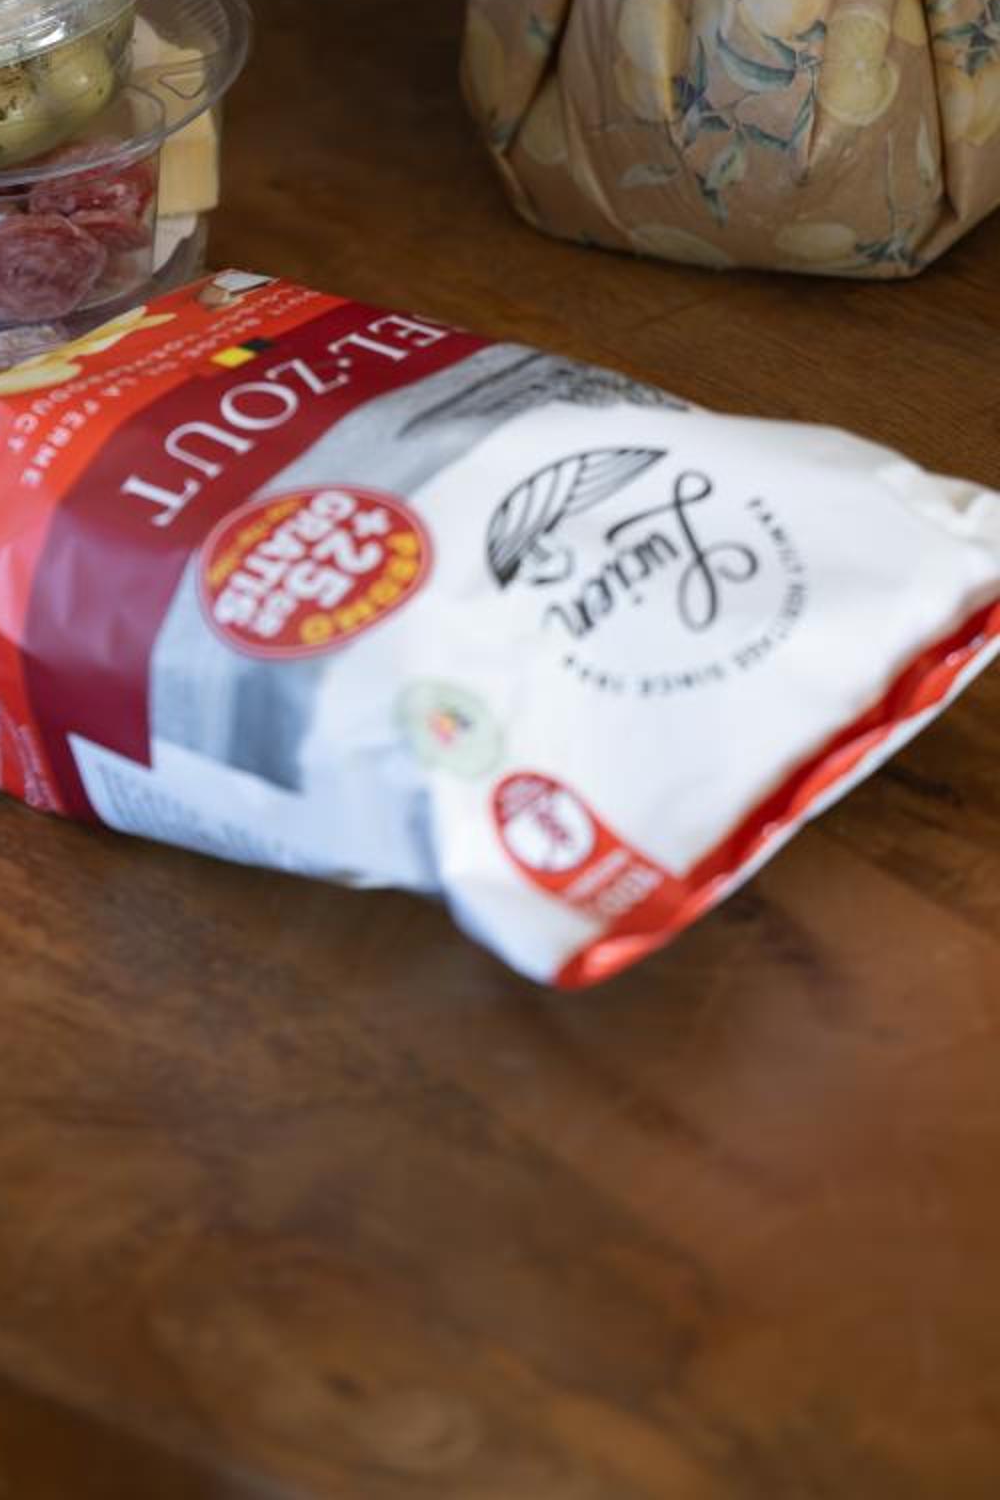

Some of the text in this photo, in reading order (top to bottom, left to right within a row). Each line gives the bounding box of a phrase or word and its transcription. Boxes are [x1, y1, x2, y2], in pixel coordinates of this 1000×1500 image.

[20, 398, 101, 489] FERME
[213, 490, 359, 626] GRATIS
[300, 531, 419, 645] PROMO
[538, 469, 759, 640] Lucien
